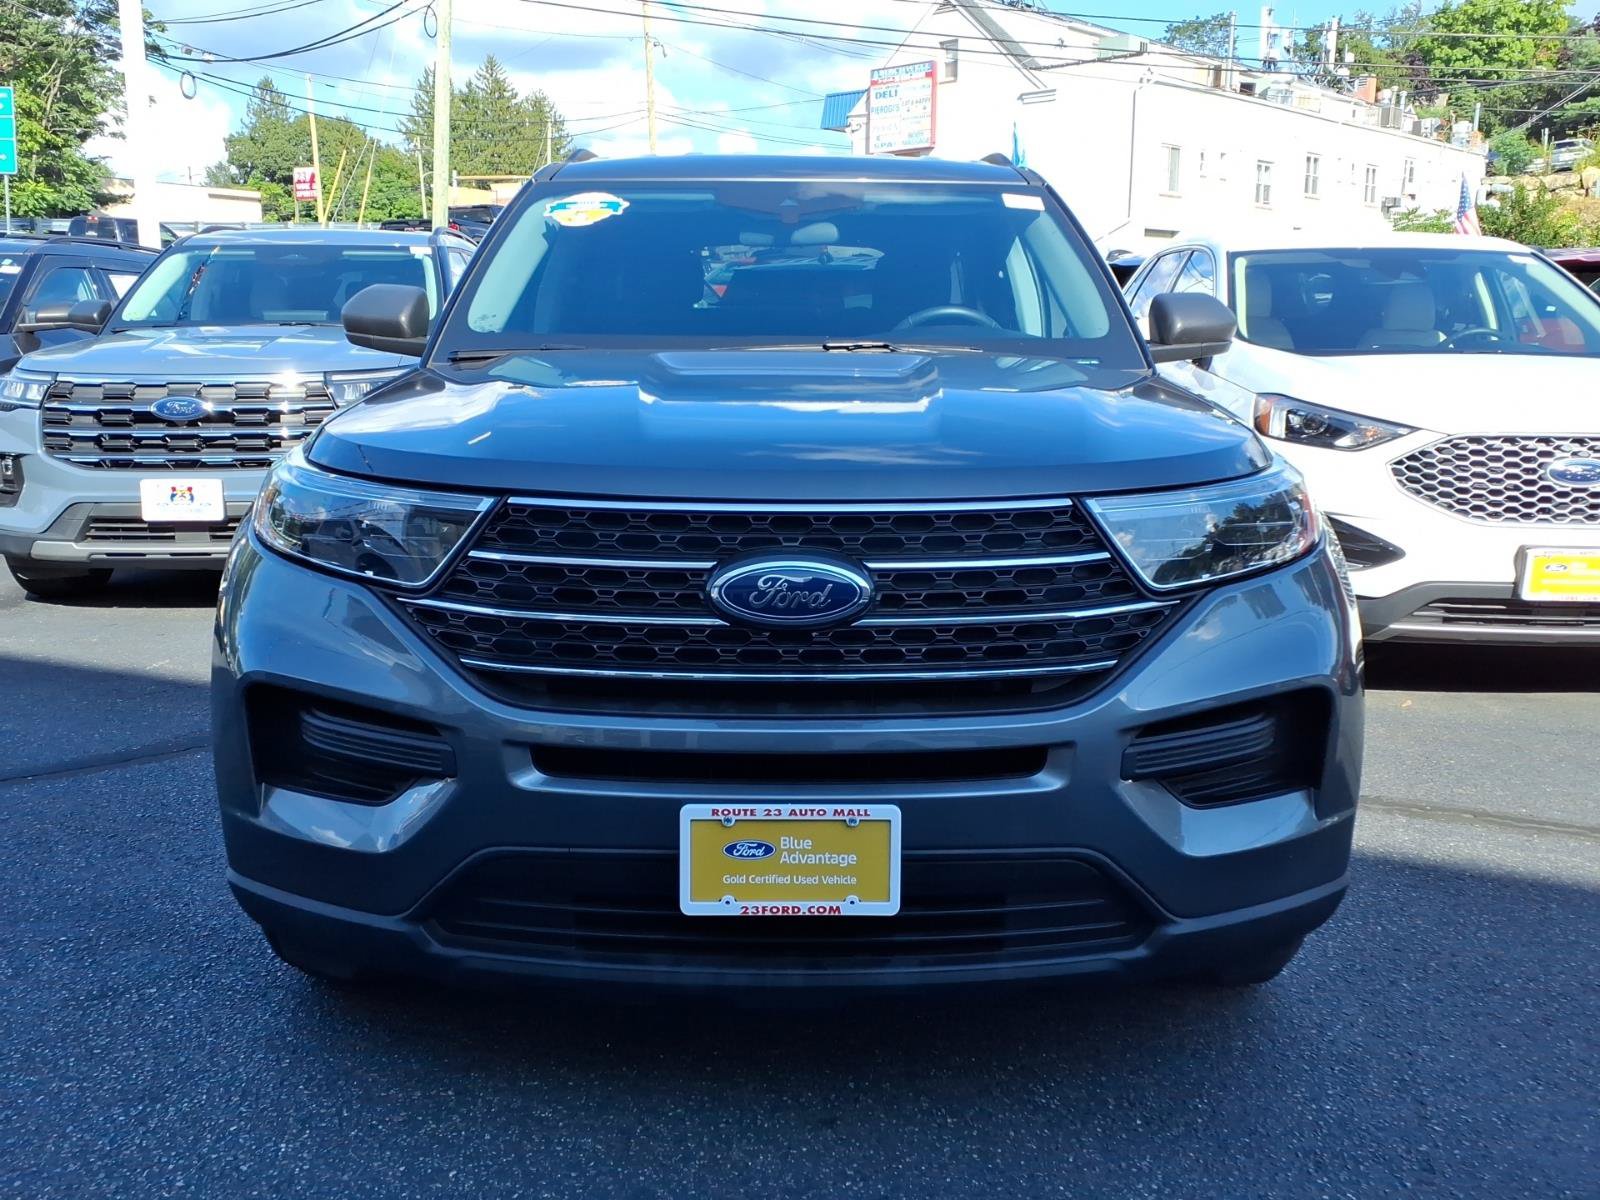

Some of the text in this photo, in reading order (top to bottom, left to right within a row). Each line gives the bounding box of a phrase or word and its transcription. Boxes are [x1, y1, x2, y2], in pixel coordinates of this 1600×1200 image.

[875, 88, 898, 100] DELI
[749, 574, 833, 608] Ford
[711, 808, 871, 817] ROUTE 23 AUTO MALL
[780, 836, 813, 849] Blue
[732, 842, 765, 857] Ford
[779, 851, 857, 867] Advantage
[722, 874, 857, 884] Gold Certified Used Vehicle
[740, 905, 841, 915] 23FORD.COM
